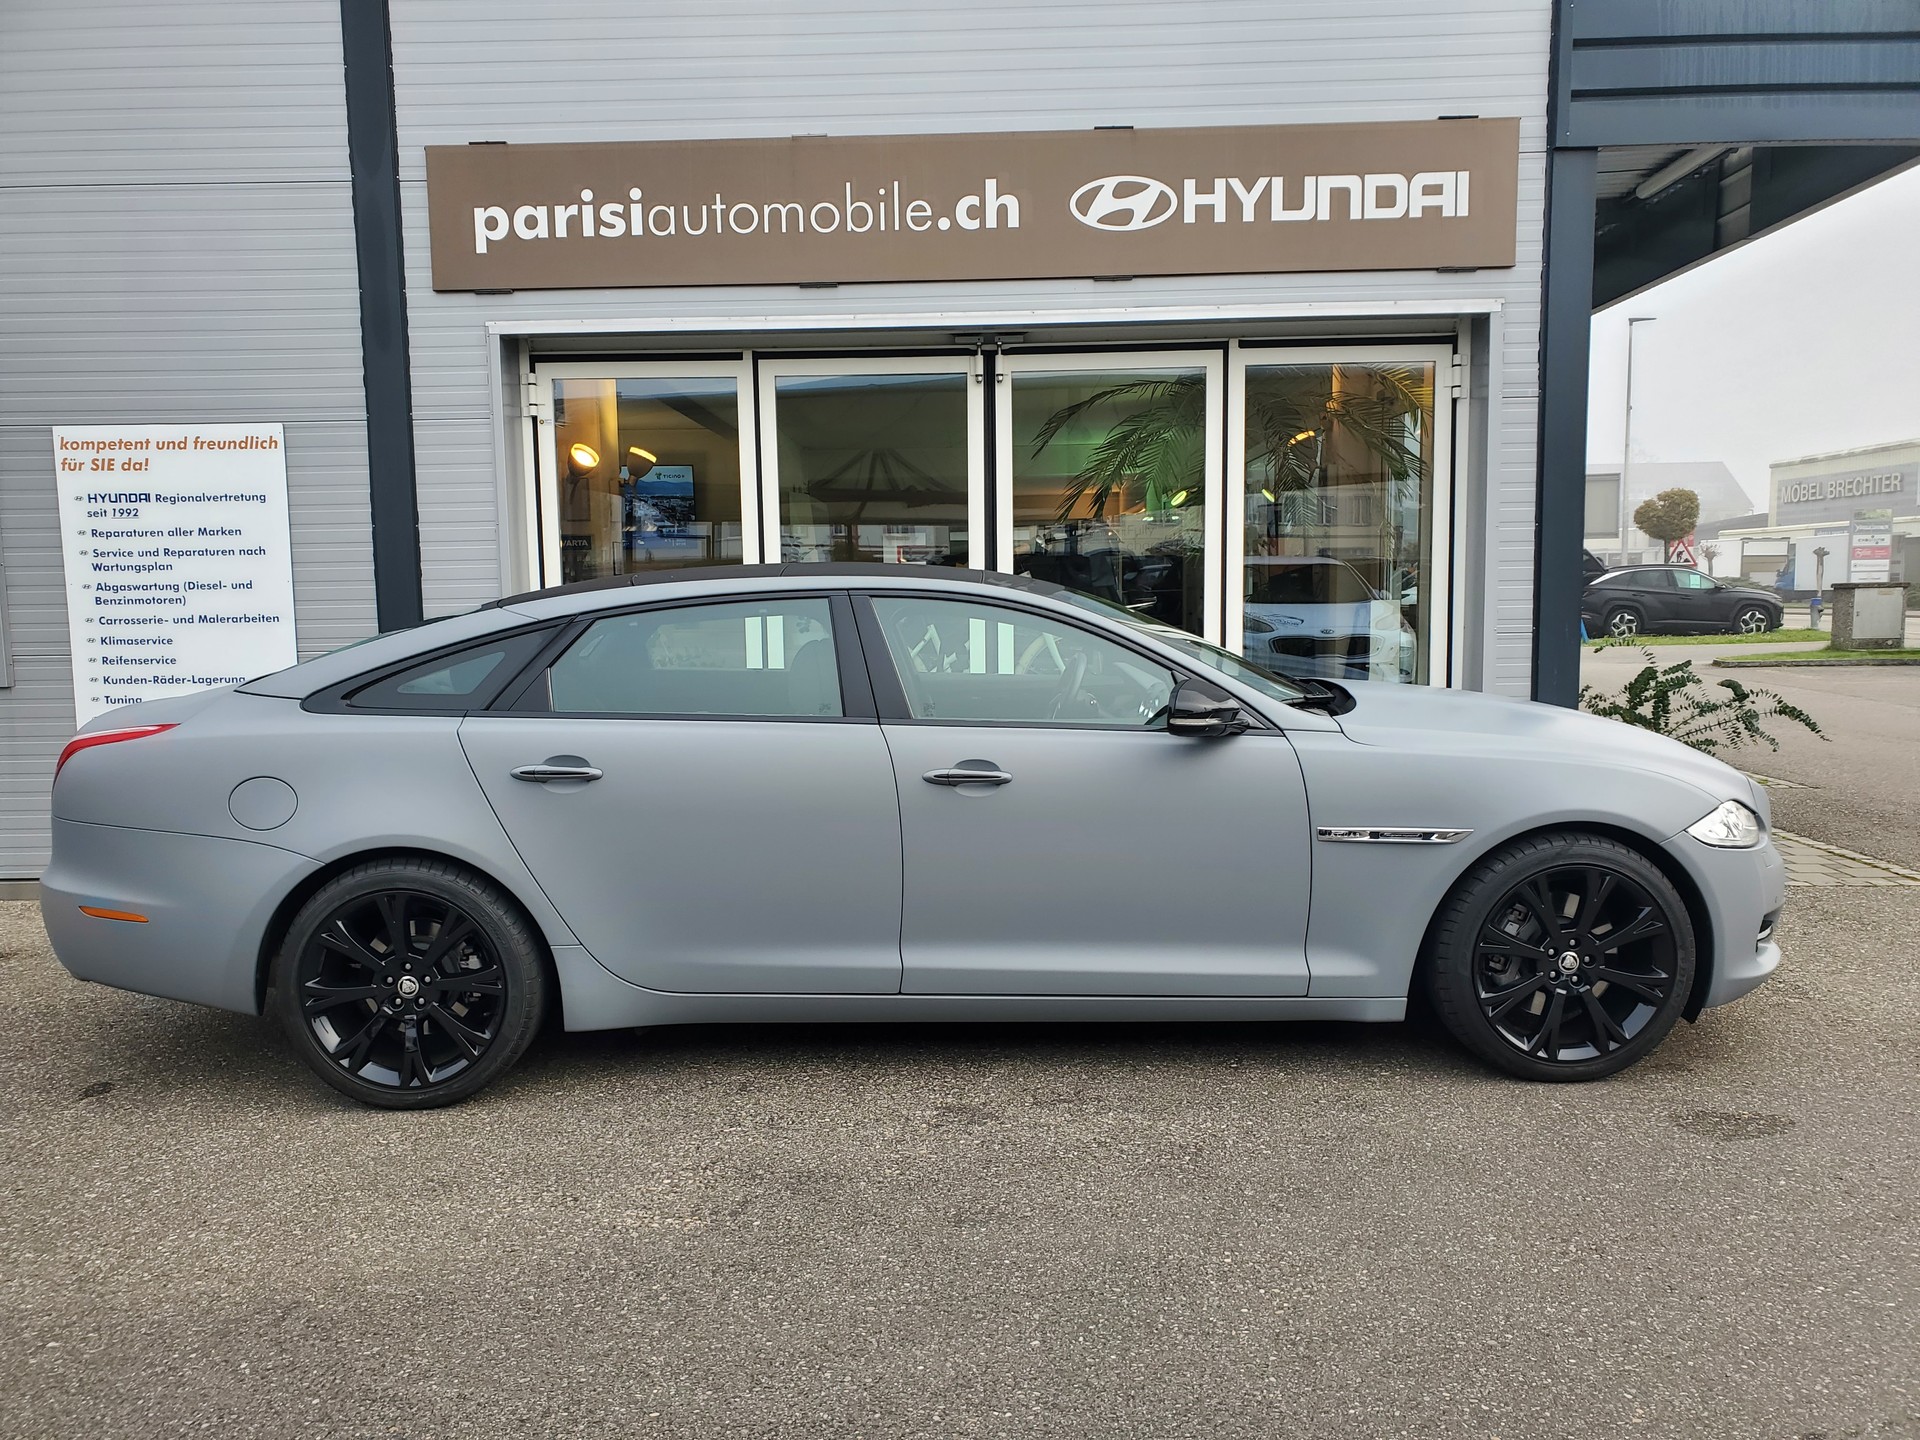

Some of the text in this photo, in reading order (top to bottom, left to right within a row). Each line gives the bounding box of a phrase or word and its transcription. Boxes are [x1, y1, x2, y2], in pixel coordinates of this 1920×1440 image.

[1183, 170, 1470, 224] HYUNDAI
[473, 178, 1020, 254] parisiautomobile.ch
[59, 435, 279, 454] kompetent und freundlich
[60, 457, 149, 472] für SIE da!
[1781, 473, 1901, 503] MÖBEL BRECHTER
[87, 492, 267, 505] HYUNDAI Regionalvertretung
[86, 507, 139, 518] seit 1992
[90, 526, 242, 540] Reparaturen aller Marken
[92, 545, 266, 559] Service und Reparaturen nach
[91, 561, 173, 574] Wartungsplan
[95, 579, 253, 594] Abgaswartung (Diesel- und
[94, 594, 187, 607] Benzinmotoren)
[98, 612, 281, 626] Carrosserie- und Malerarbeiten
[100, 635, 174, 646] Klimaservice
[101, 655, 177, 666] Reifenservice
